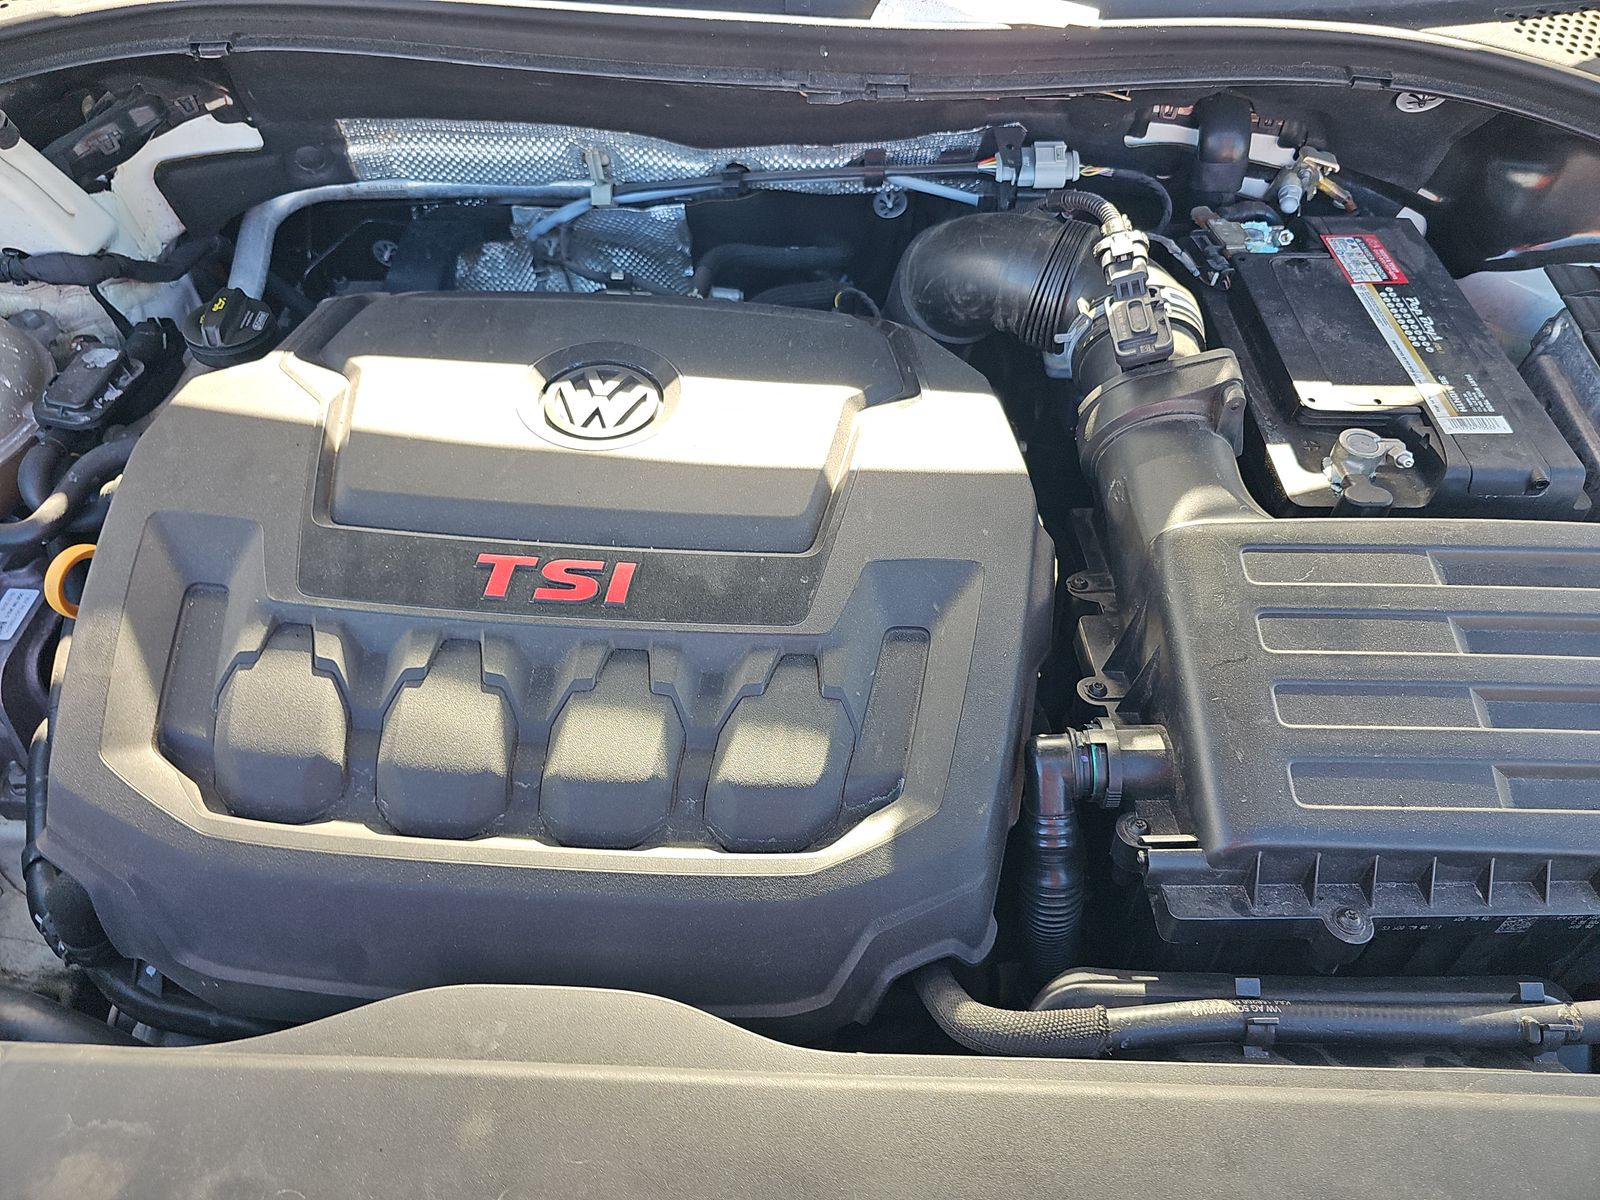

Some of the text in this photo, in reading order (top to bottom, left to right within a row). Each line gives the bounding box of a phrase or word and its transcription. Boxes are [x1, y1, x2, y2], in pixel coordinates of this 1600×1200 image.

[1405, 296, 1423, 316] Pep
[1419, 316, 1443, 341] Boys
[545, 366, 660, 437] VW
[476, 553, 638, 605] TSI
[1249, 1004, 1264, 1013] AG
[1266, 1004, 1282, 1013] VW
